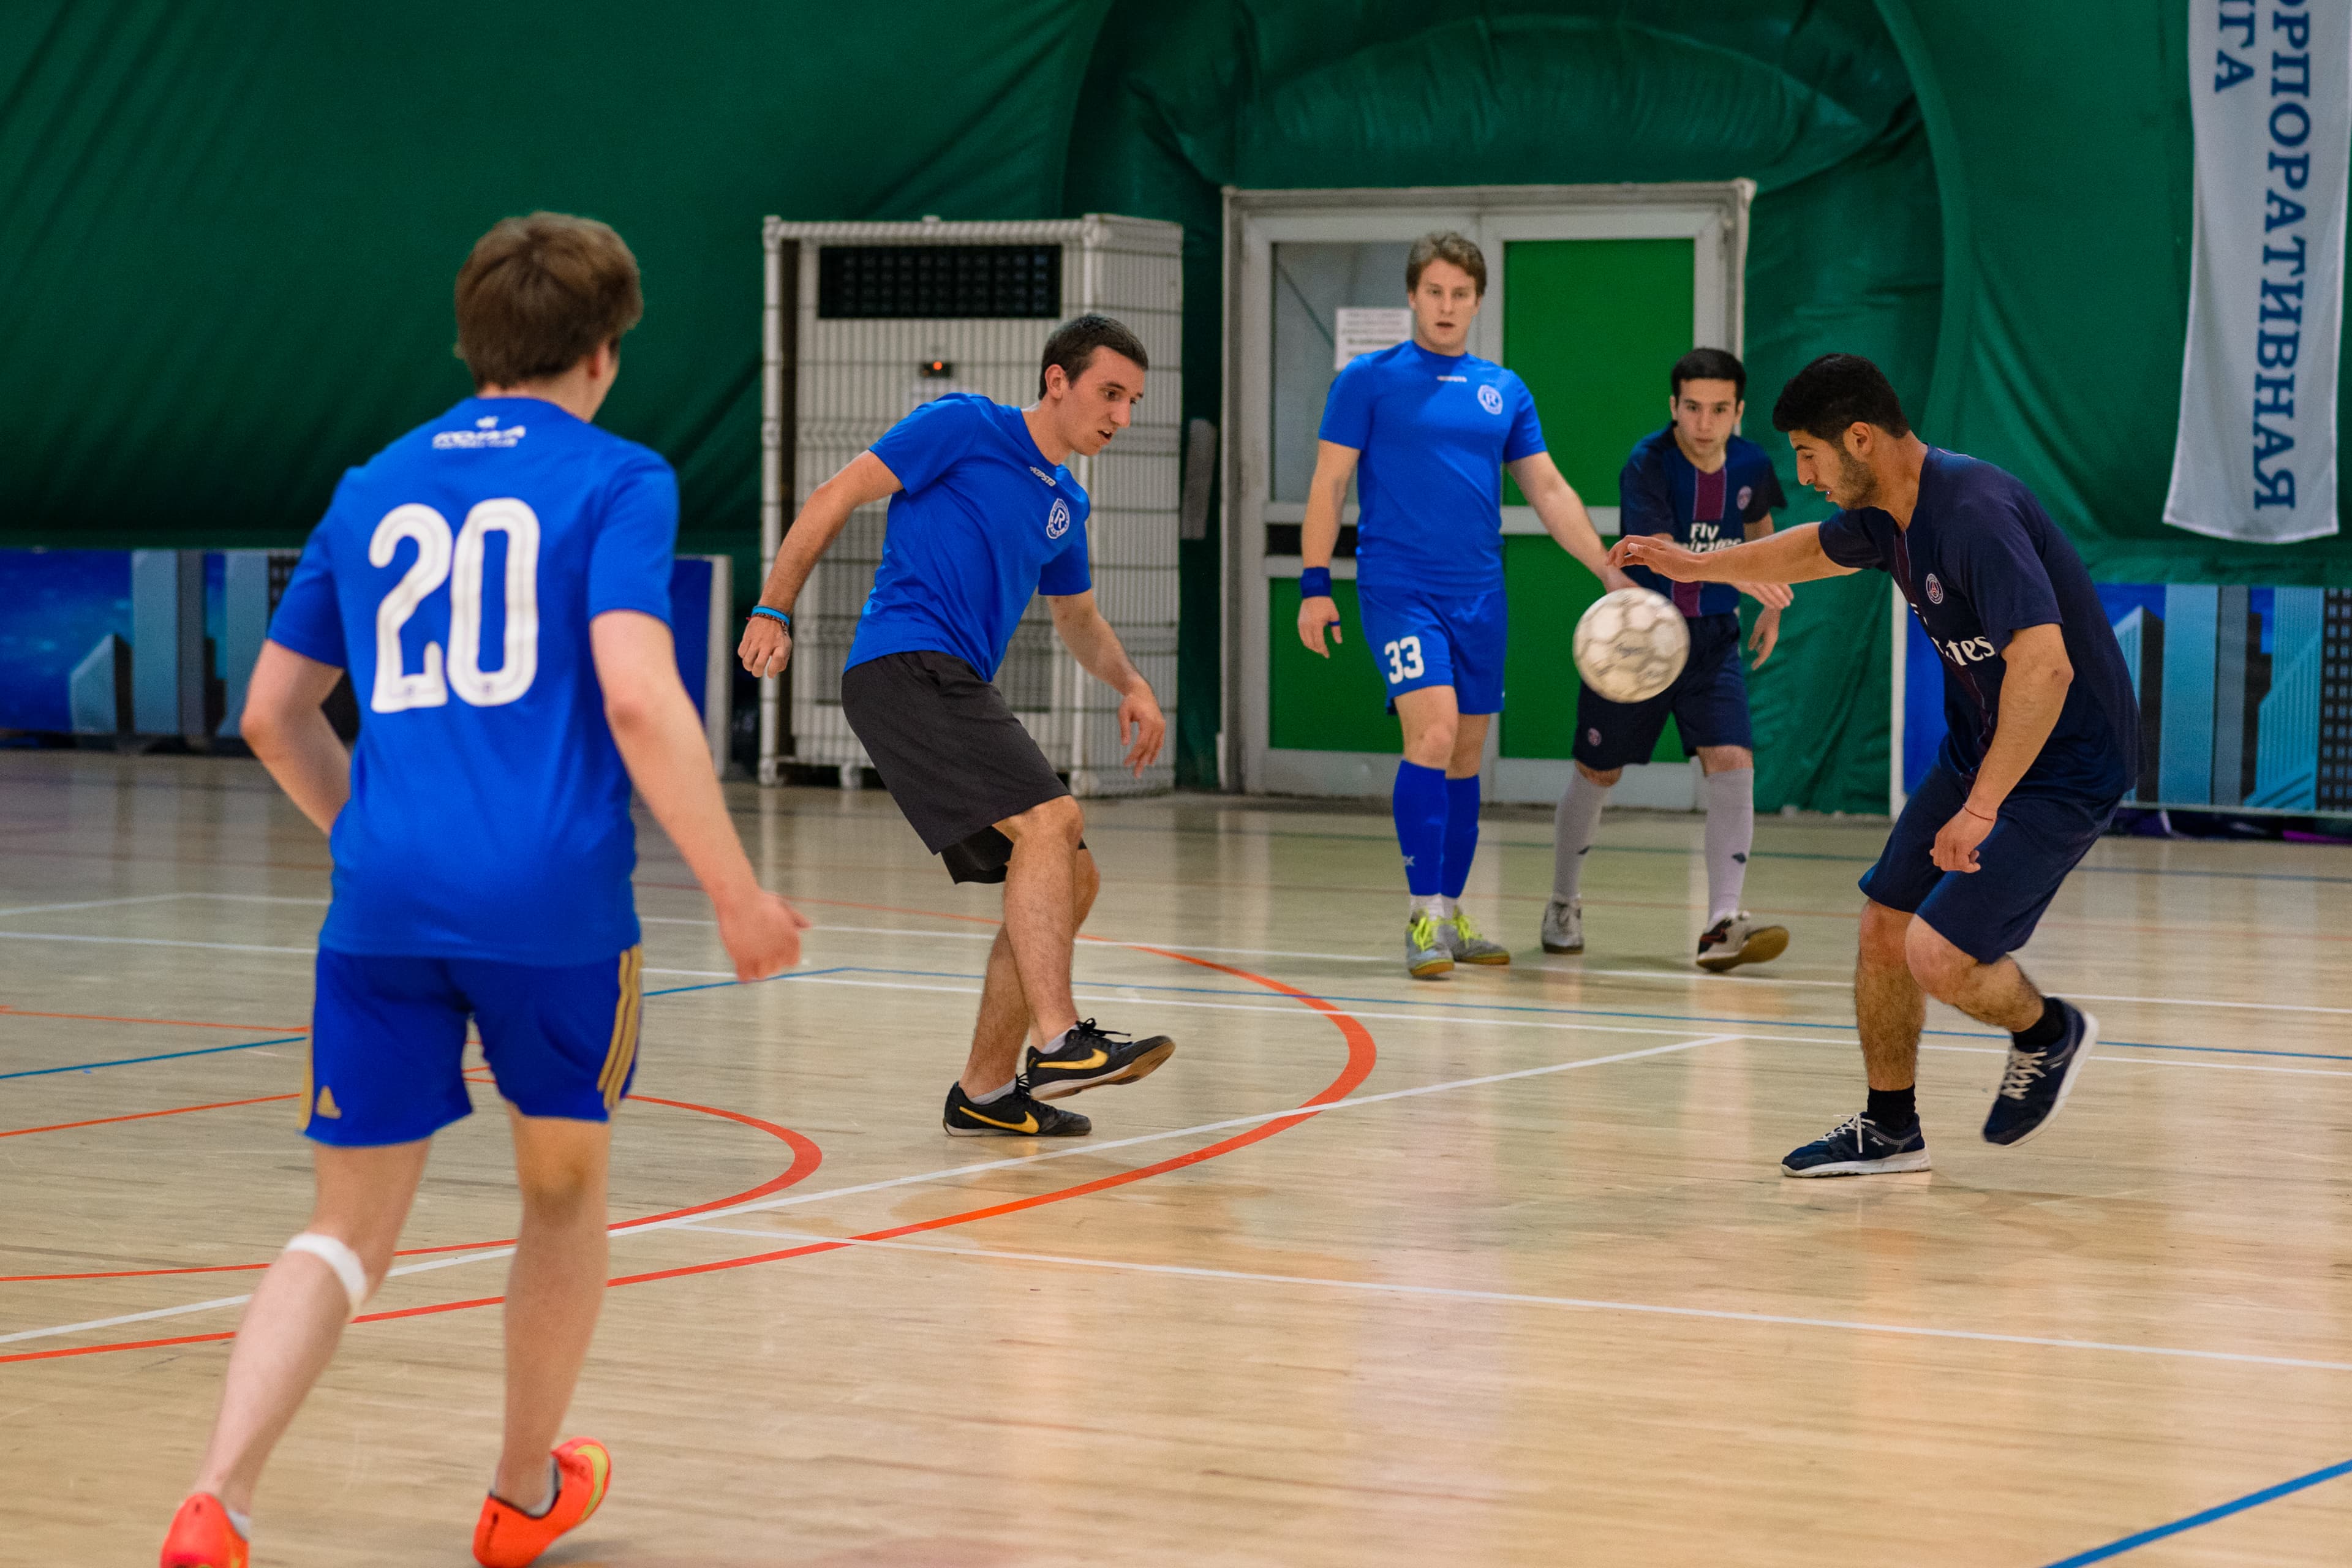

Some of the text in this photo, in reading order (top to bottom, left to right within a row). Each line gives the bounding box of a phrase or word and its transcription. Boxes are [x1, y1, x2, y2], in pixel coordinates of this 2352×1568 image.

[2215, 0, 2256, 92] ГА
[1690, 522, 1720, 541] Fly
[369, 497, 540, 713] 20
[1384, 635, 1425, 684] 33
